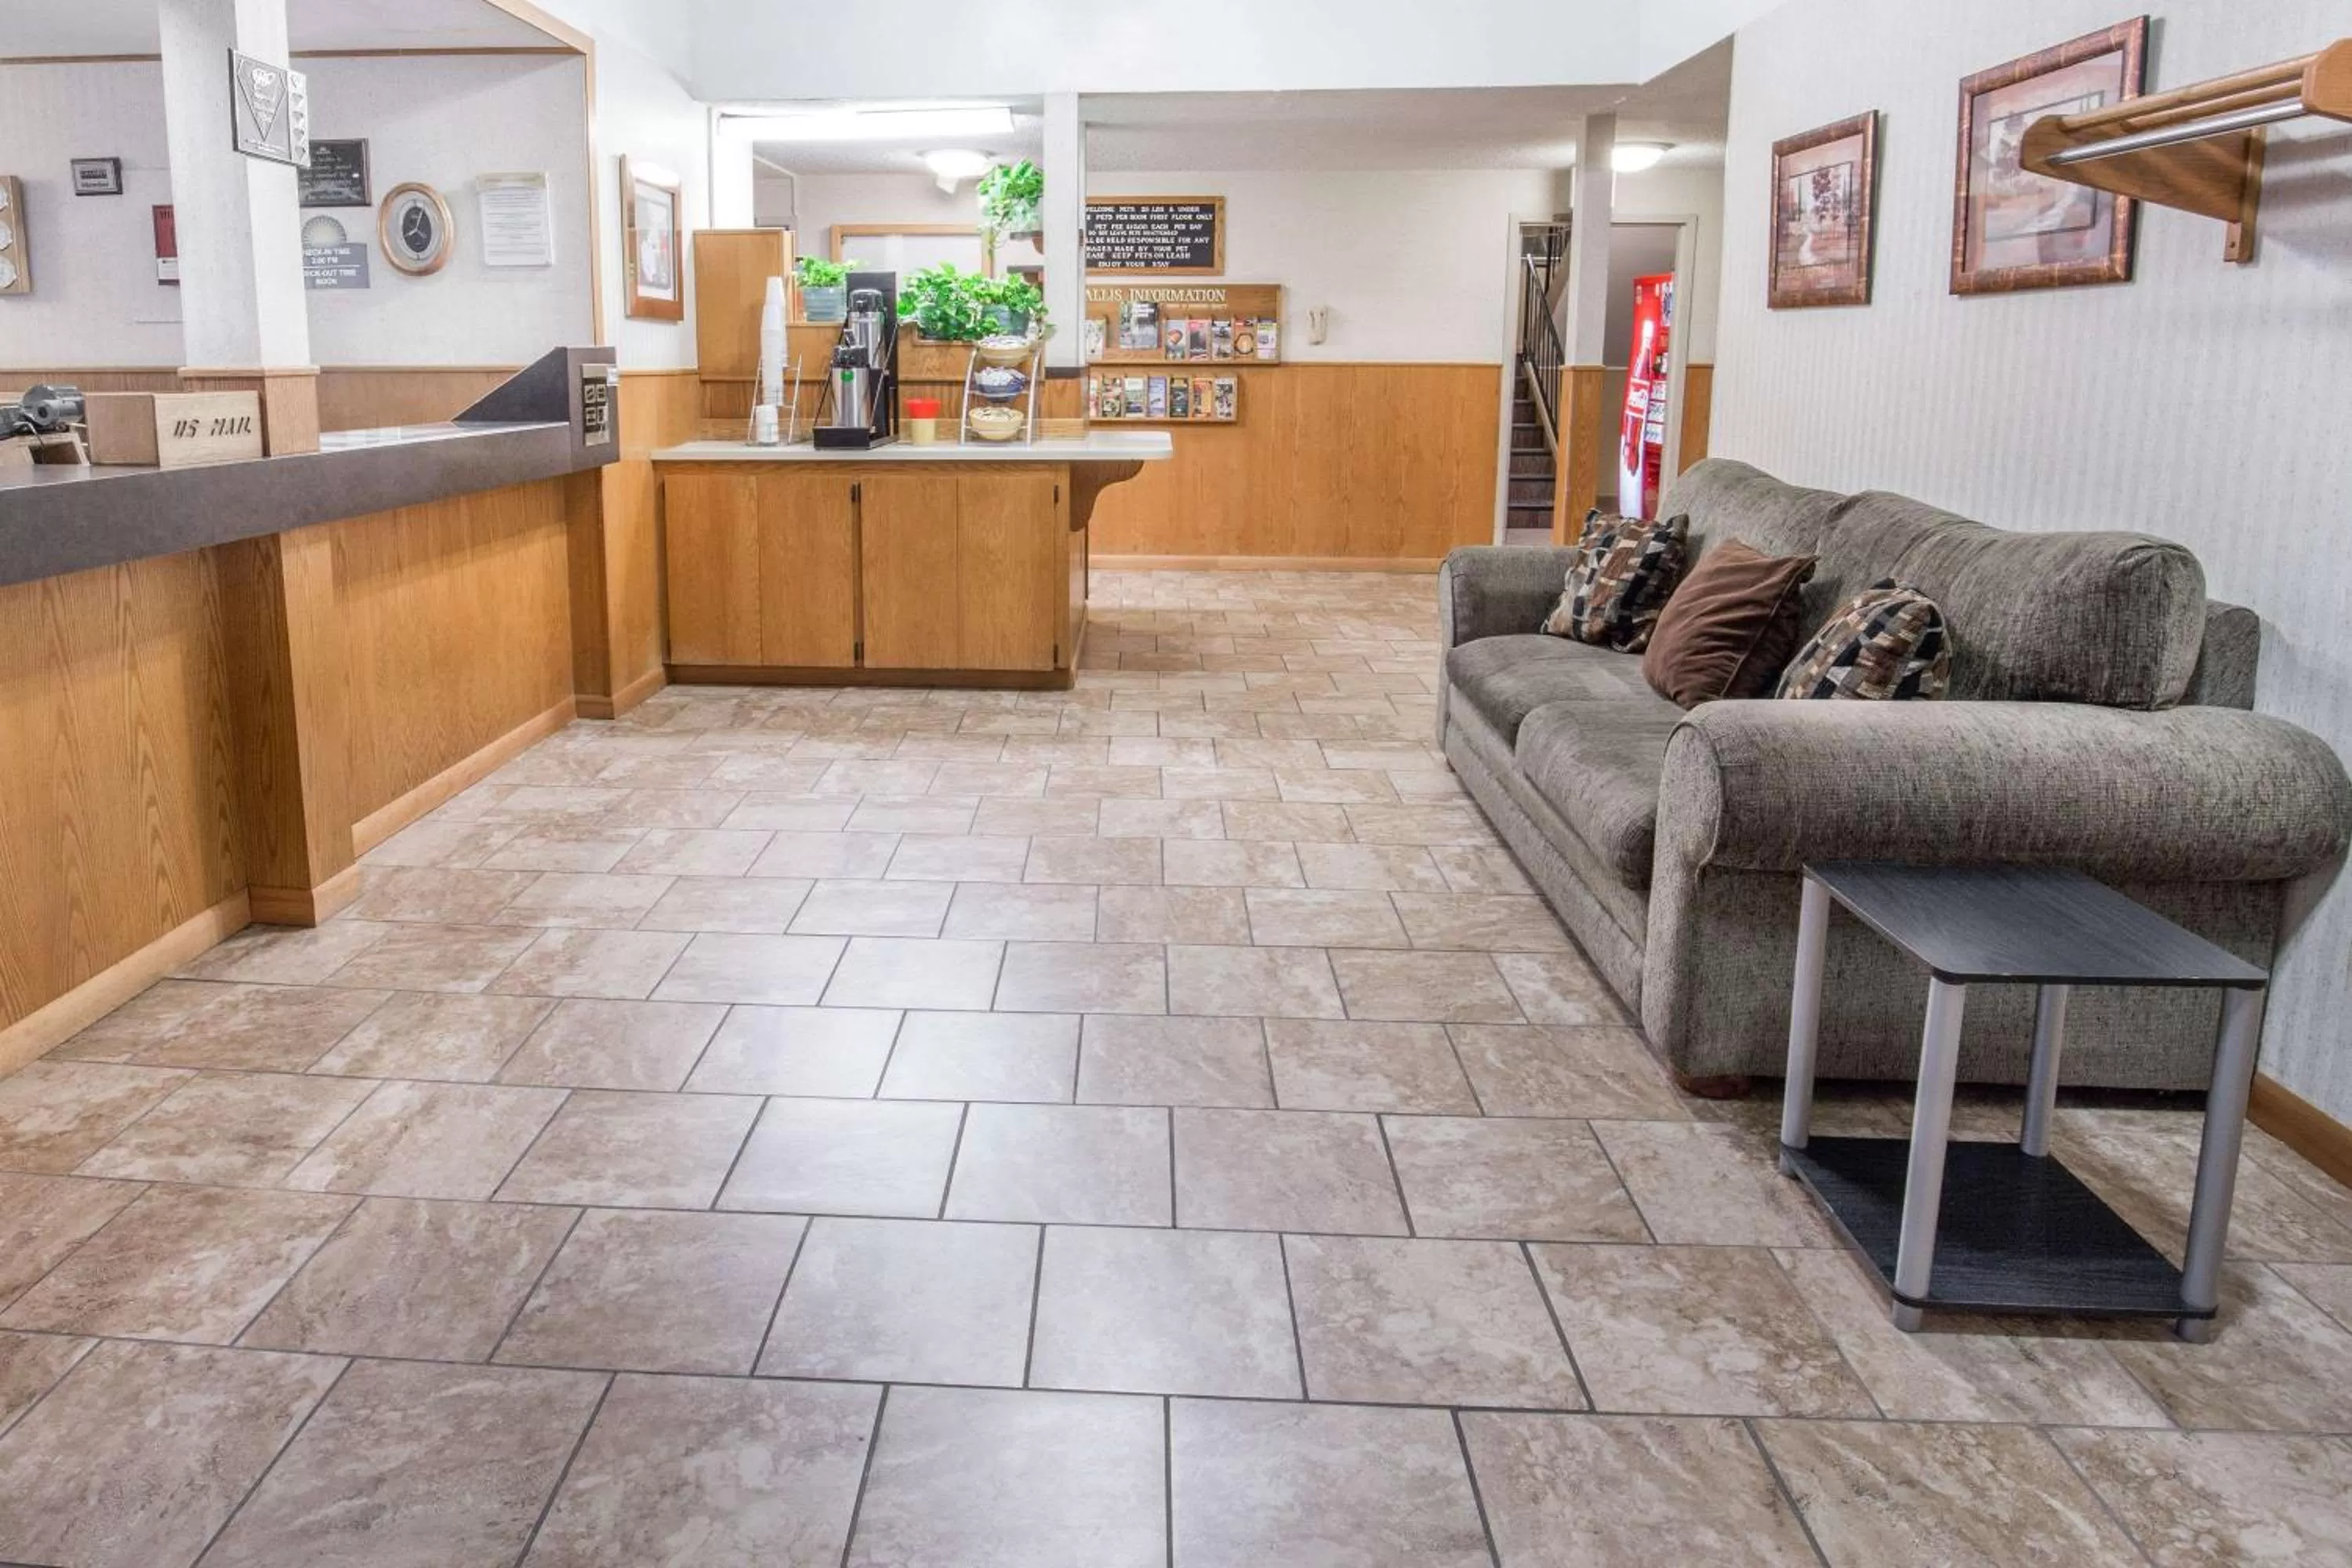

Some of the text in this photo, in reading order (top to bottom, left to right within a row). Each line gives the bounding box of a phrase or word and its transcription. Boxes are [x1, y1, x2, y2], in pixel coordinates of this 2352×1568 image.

[1086, 288, 1226, 302] ALLIS INFORMATION
[173, 416, 252, 438] US MAIL
